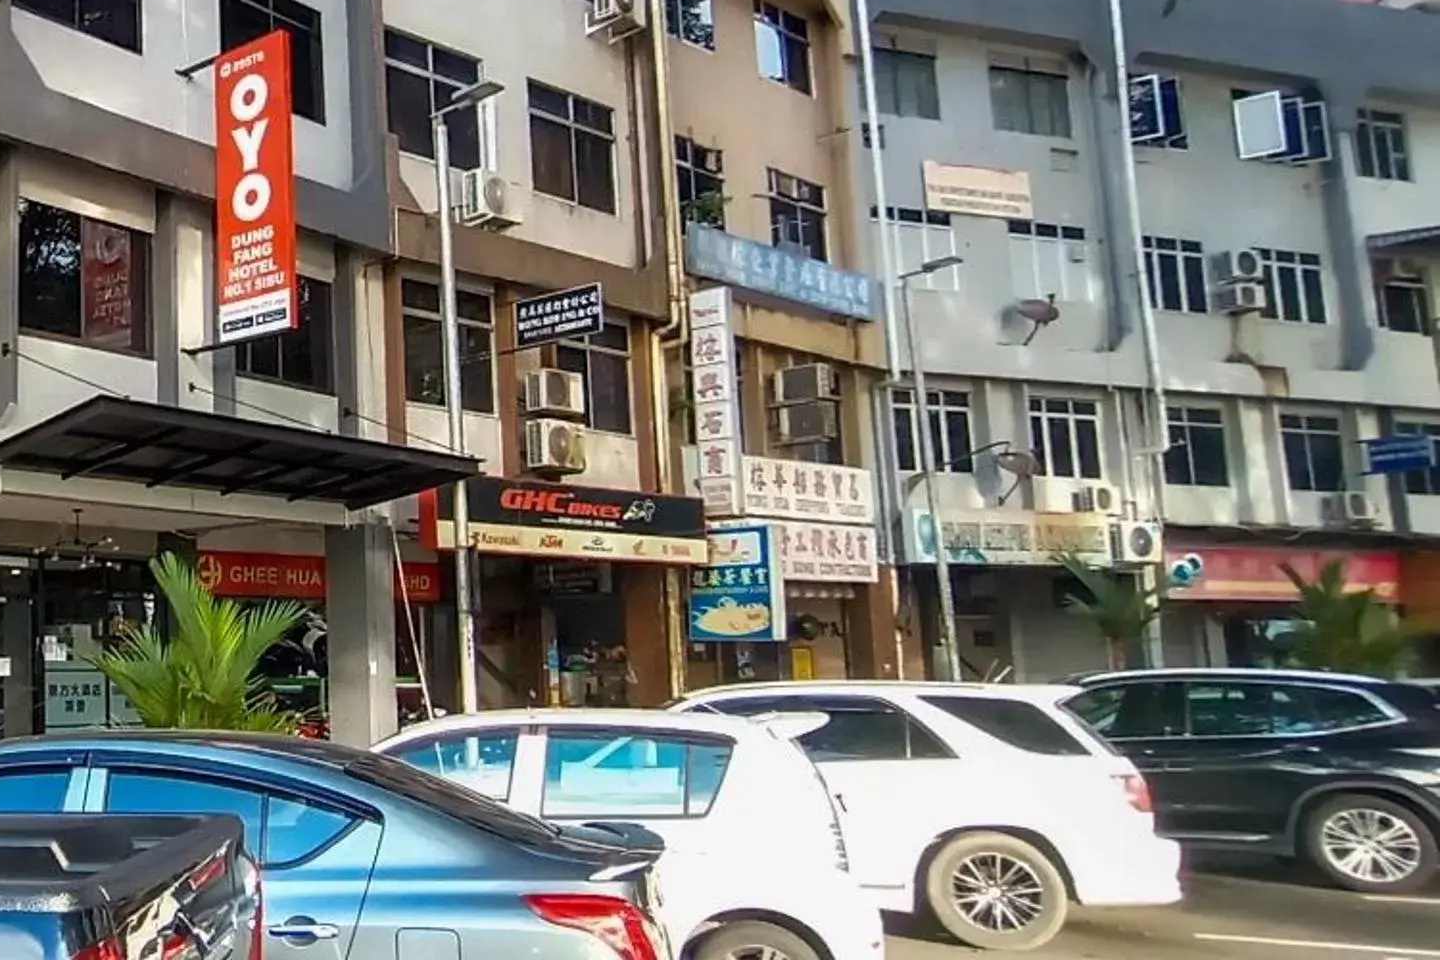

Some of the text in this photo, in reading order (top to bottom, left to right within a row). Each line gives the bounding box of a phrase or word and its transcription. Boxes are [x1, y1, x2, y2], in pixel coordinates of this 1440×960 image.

[230, 73, 272, 222] OYO
[232, 225, 274, 249] DUNG
[234, 242, 273, 264] FANG
[228, 257, 279, 282] HOTEL
[254, 271, 285, 290] SIBU
[500, 488, 568, 514] GHC
[230, 565, 277, 585] GHEE
[286, 566, 322, 586] HUA
